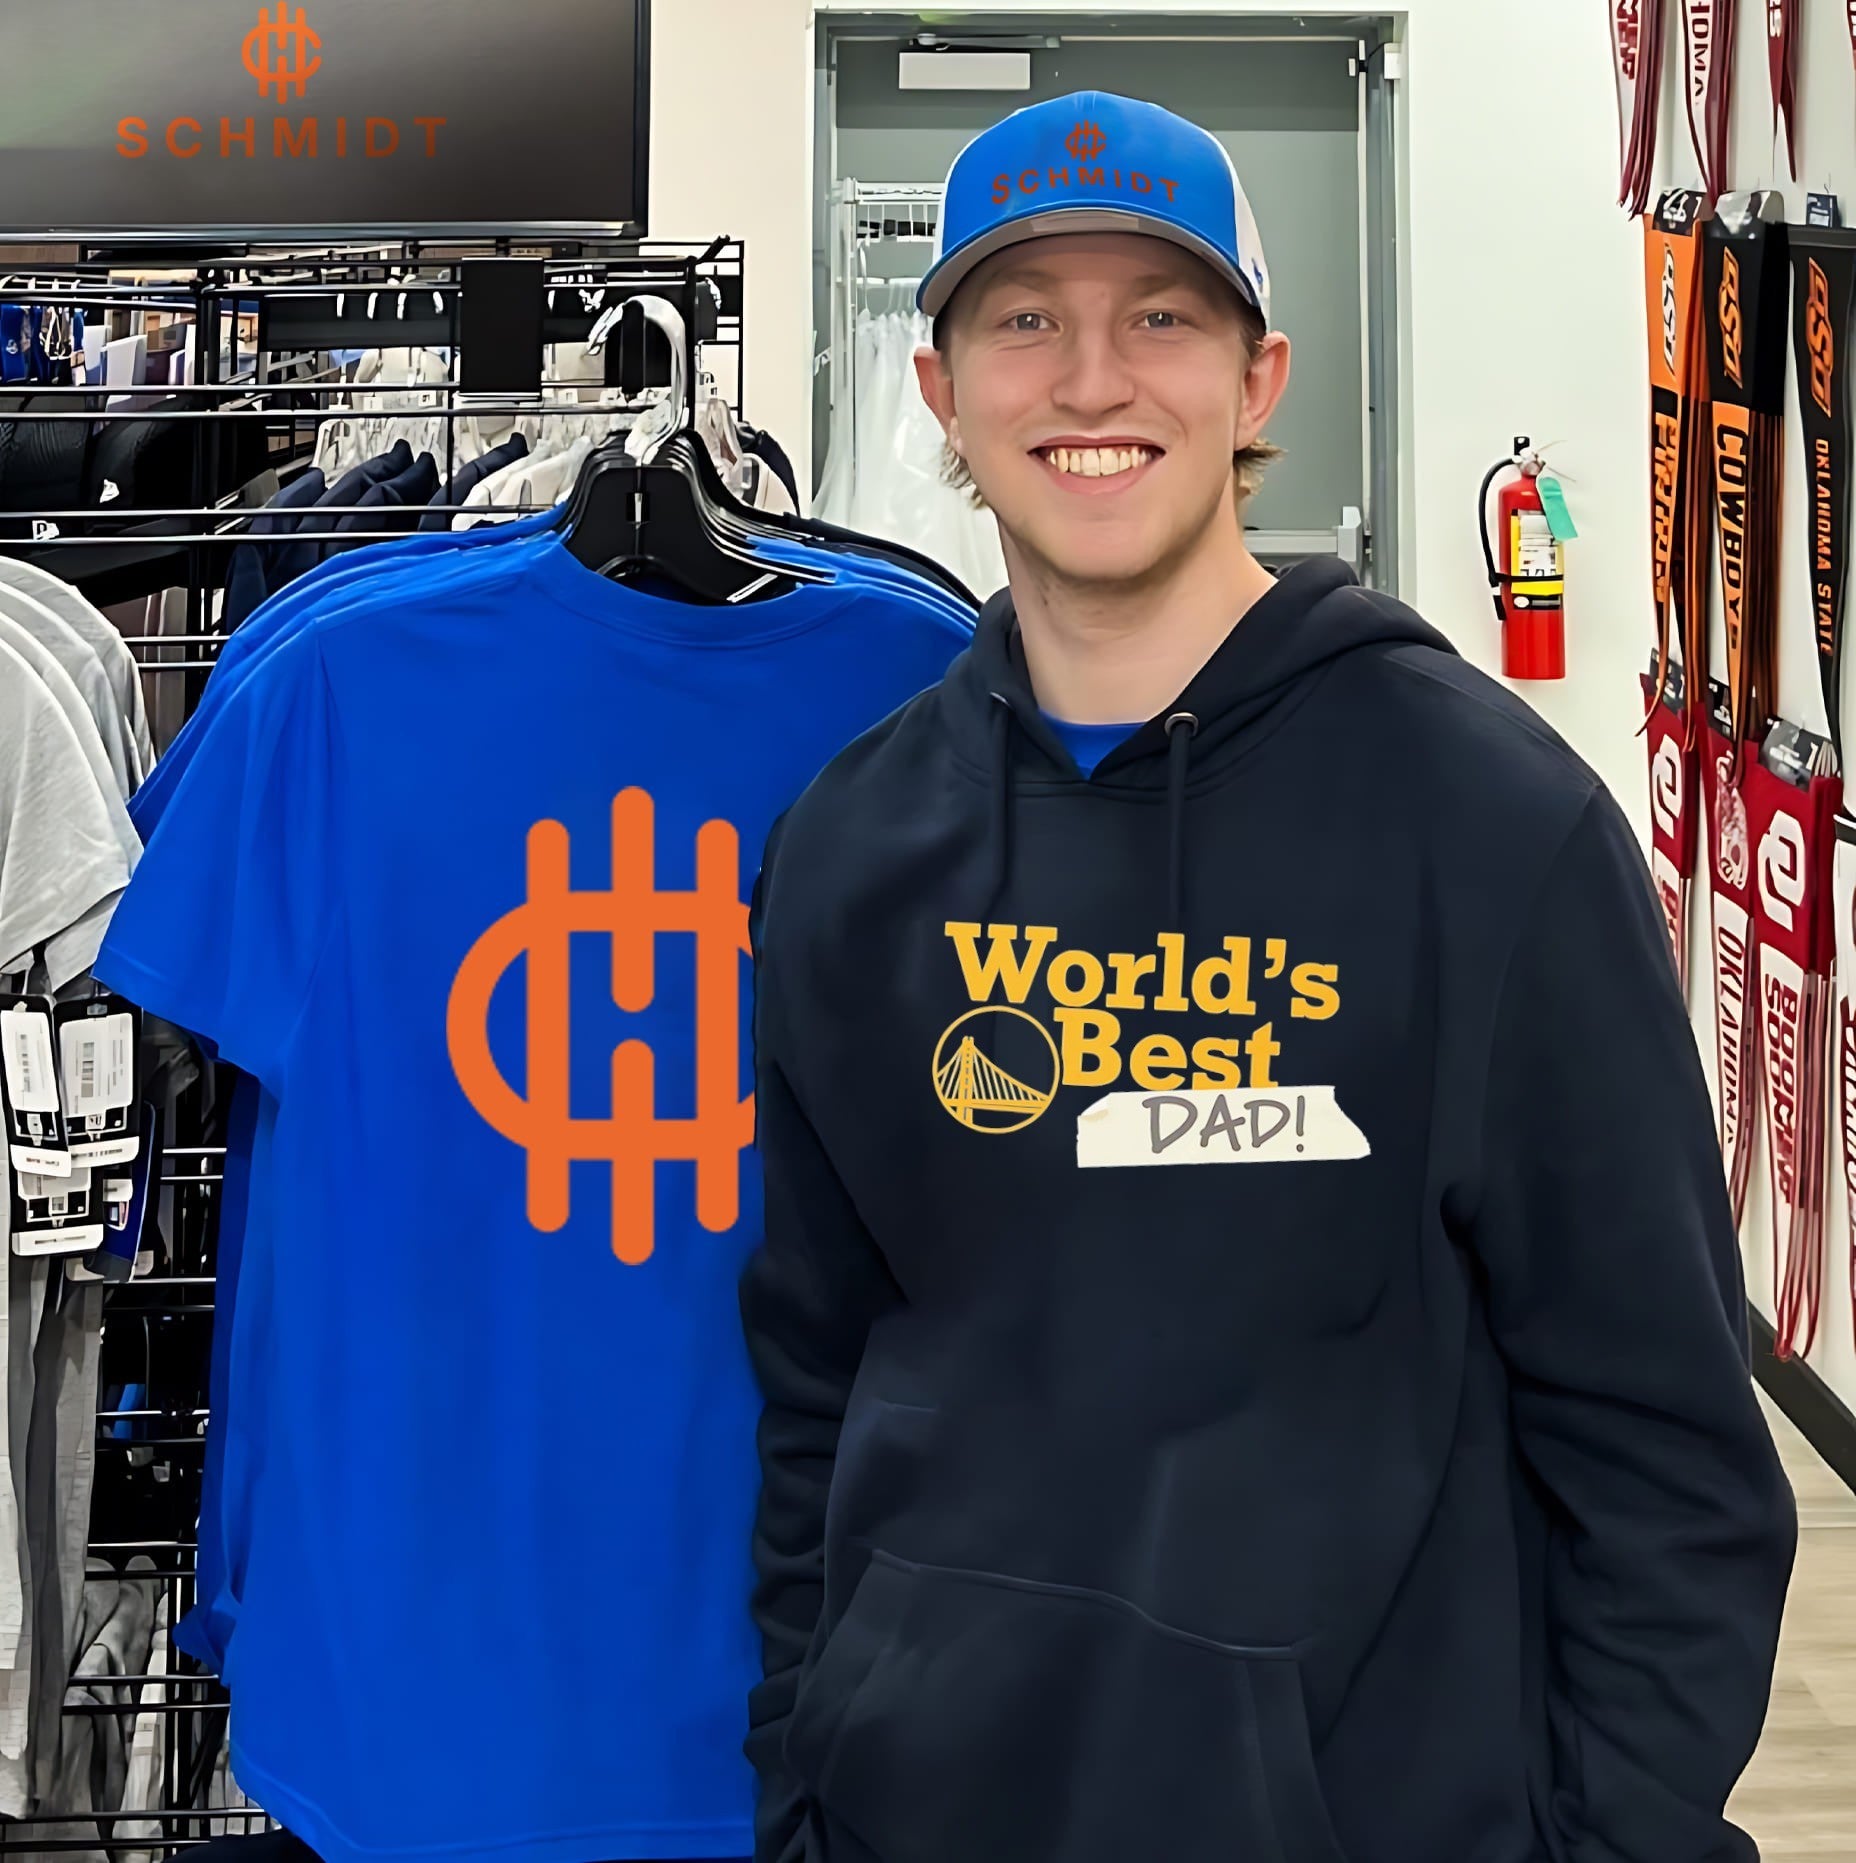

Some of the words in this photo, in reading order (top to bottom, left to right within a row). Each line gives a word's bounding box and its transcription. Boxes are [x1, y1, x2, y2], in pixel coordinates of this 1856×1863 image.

[116, 116, 448, 159] SCHMIDT
[991, 166, 1180, 205] SCHMIDT
[1815, 438, 1832, 570] OKLAHOMA
[944, 921, 1341, 1020] World's
[1053, 1006, 1281, 1091] Best
[1718, 925, 1746, 1144] OKLAHOMA
[1142, 1094, 1306, 1154] DAD!
